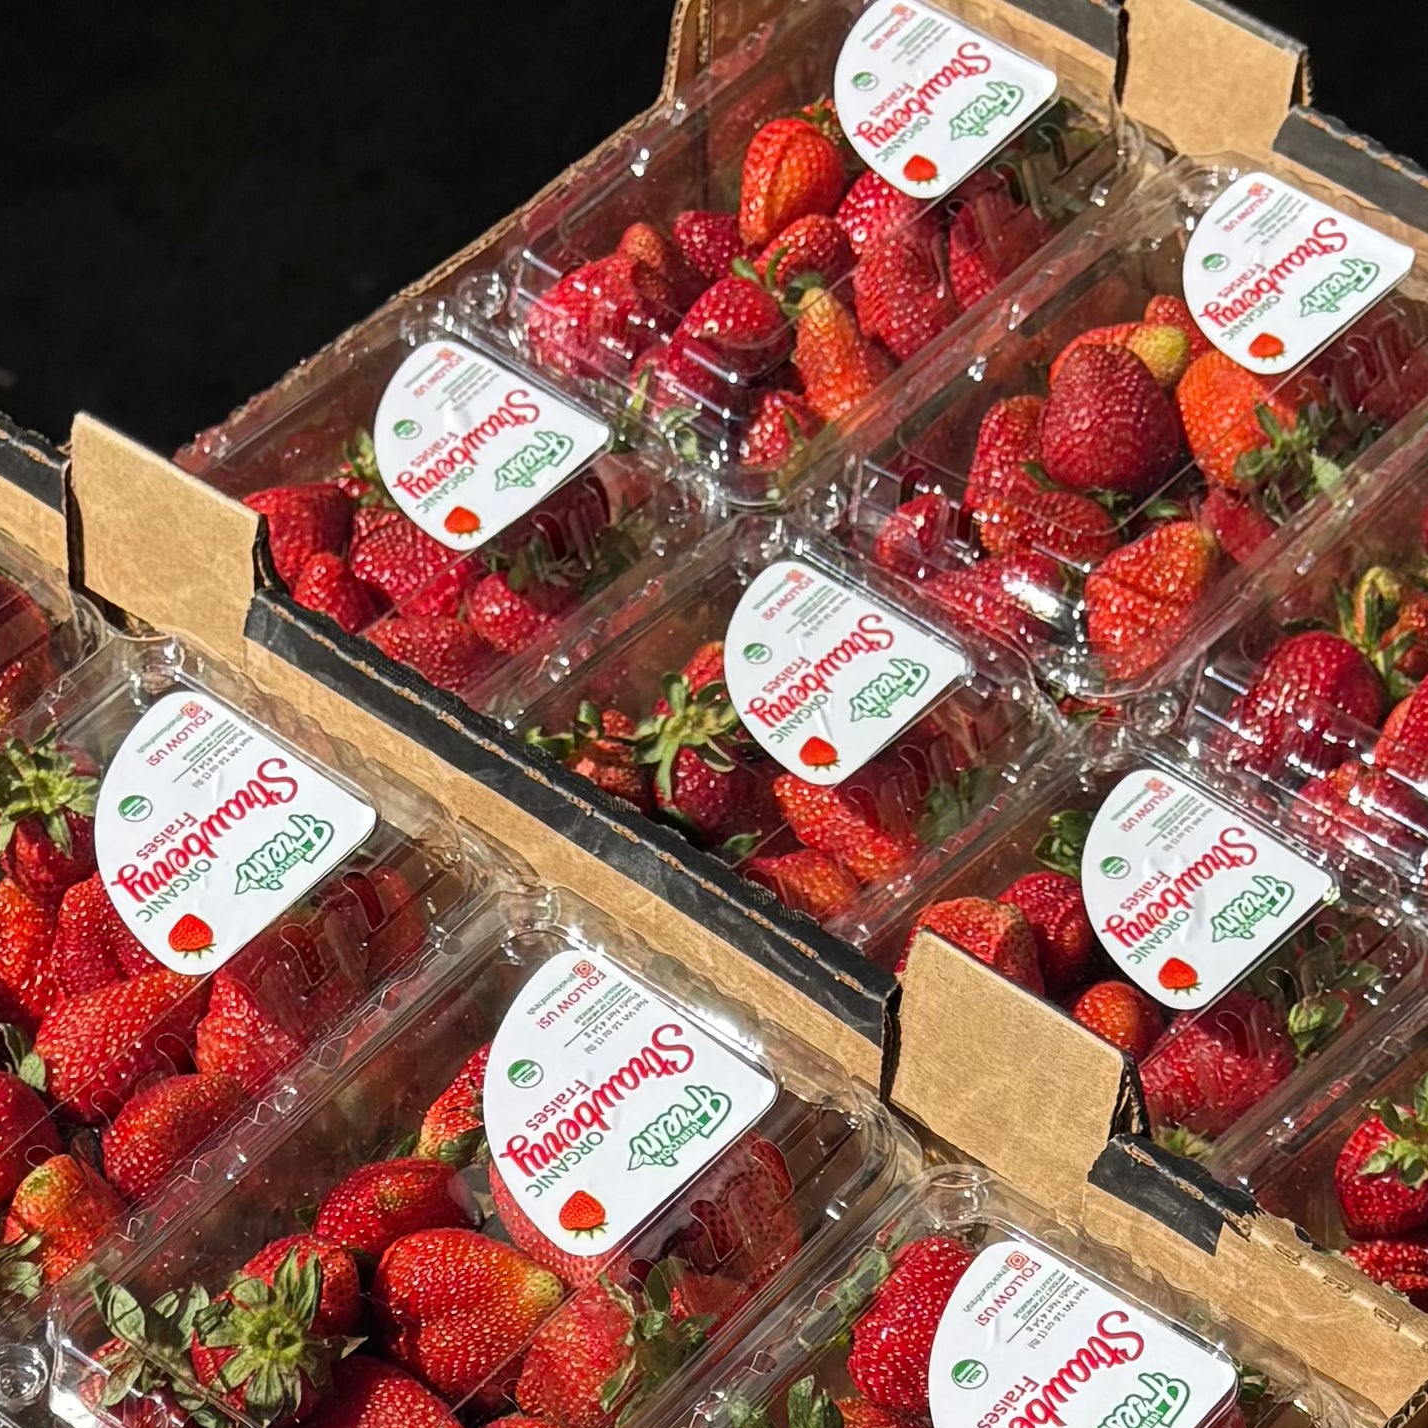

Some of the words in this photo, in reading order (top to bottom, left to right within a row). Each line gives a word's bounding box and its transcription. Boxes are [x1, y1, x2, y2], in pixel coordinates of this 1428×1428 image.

[854, 42, 992, 147] Strawberry
[876, 116, 930, 161] ORGANIC
[1203, 219, 1349, 327] Strawberry
[1223, 295, 1280, 340] ORGANIC
[392, 389, 540, 500] Strawberry
[415, 466, 474, 515] ORGANIC
[744, 614, 895, 728] Strawberry
[762, 655, 812, 694] Fraises
[769, 694, 828, 744] ORGANIC
[111, 758, 299, 903] Strawberry
[136, 810, 198, 860] Fraises
[235, 813, 333, 892] Fresh
[135, 859, 211, 923] ORGANIC
[1101, 827, 1258, 947] Strawberry
[1120, 870, 1172, 911] Fraises
[1126, 912, 1189, 965] ORGANIC
[534, 1010, 561, 1031] US!
[555, 969, 608, 1015] FOLLOW
[500, 1024, 695, 1177] Strawberry
[525, 1078, 590, 1130] Fraises
[628, 1083, 730, 1168] Fresh
[525, 1132, 604, 1199] ORGANIC
